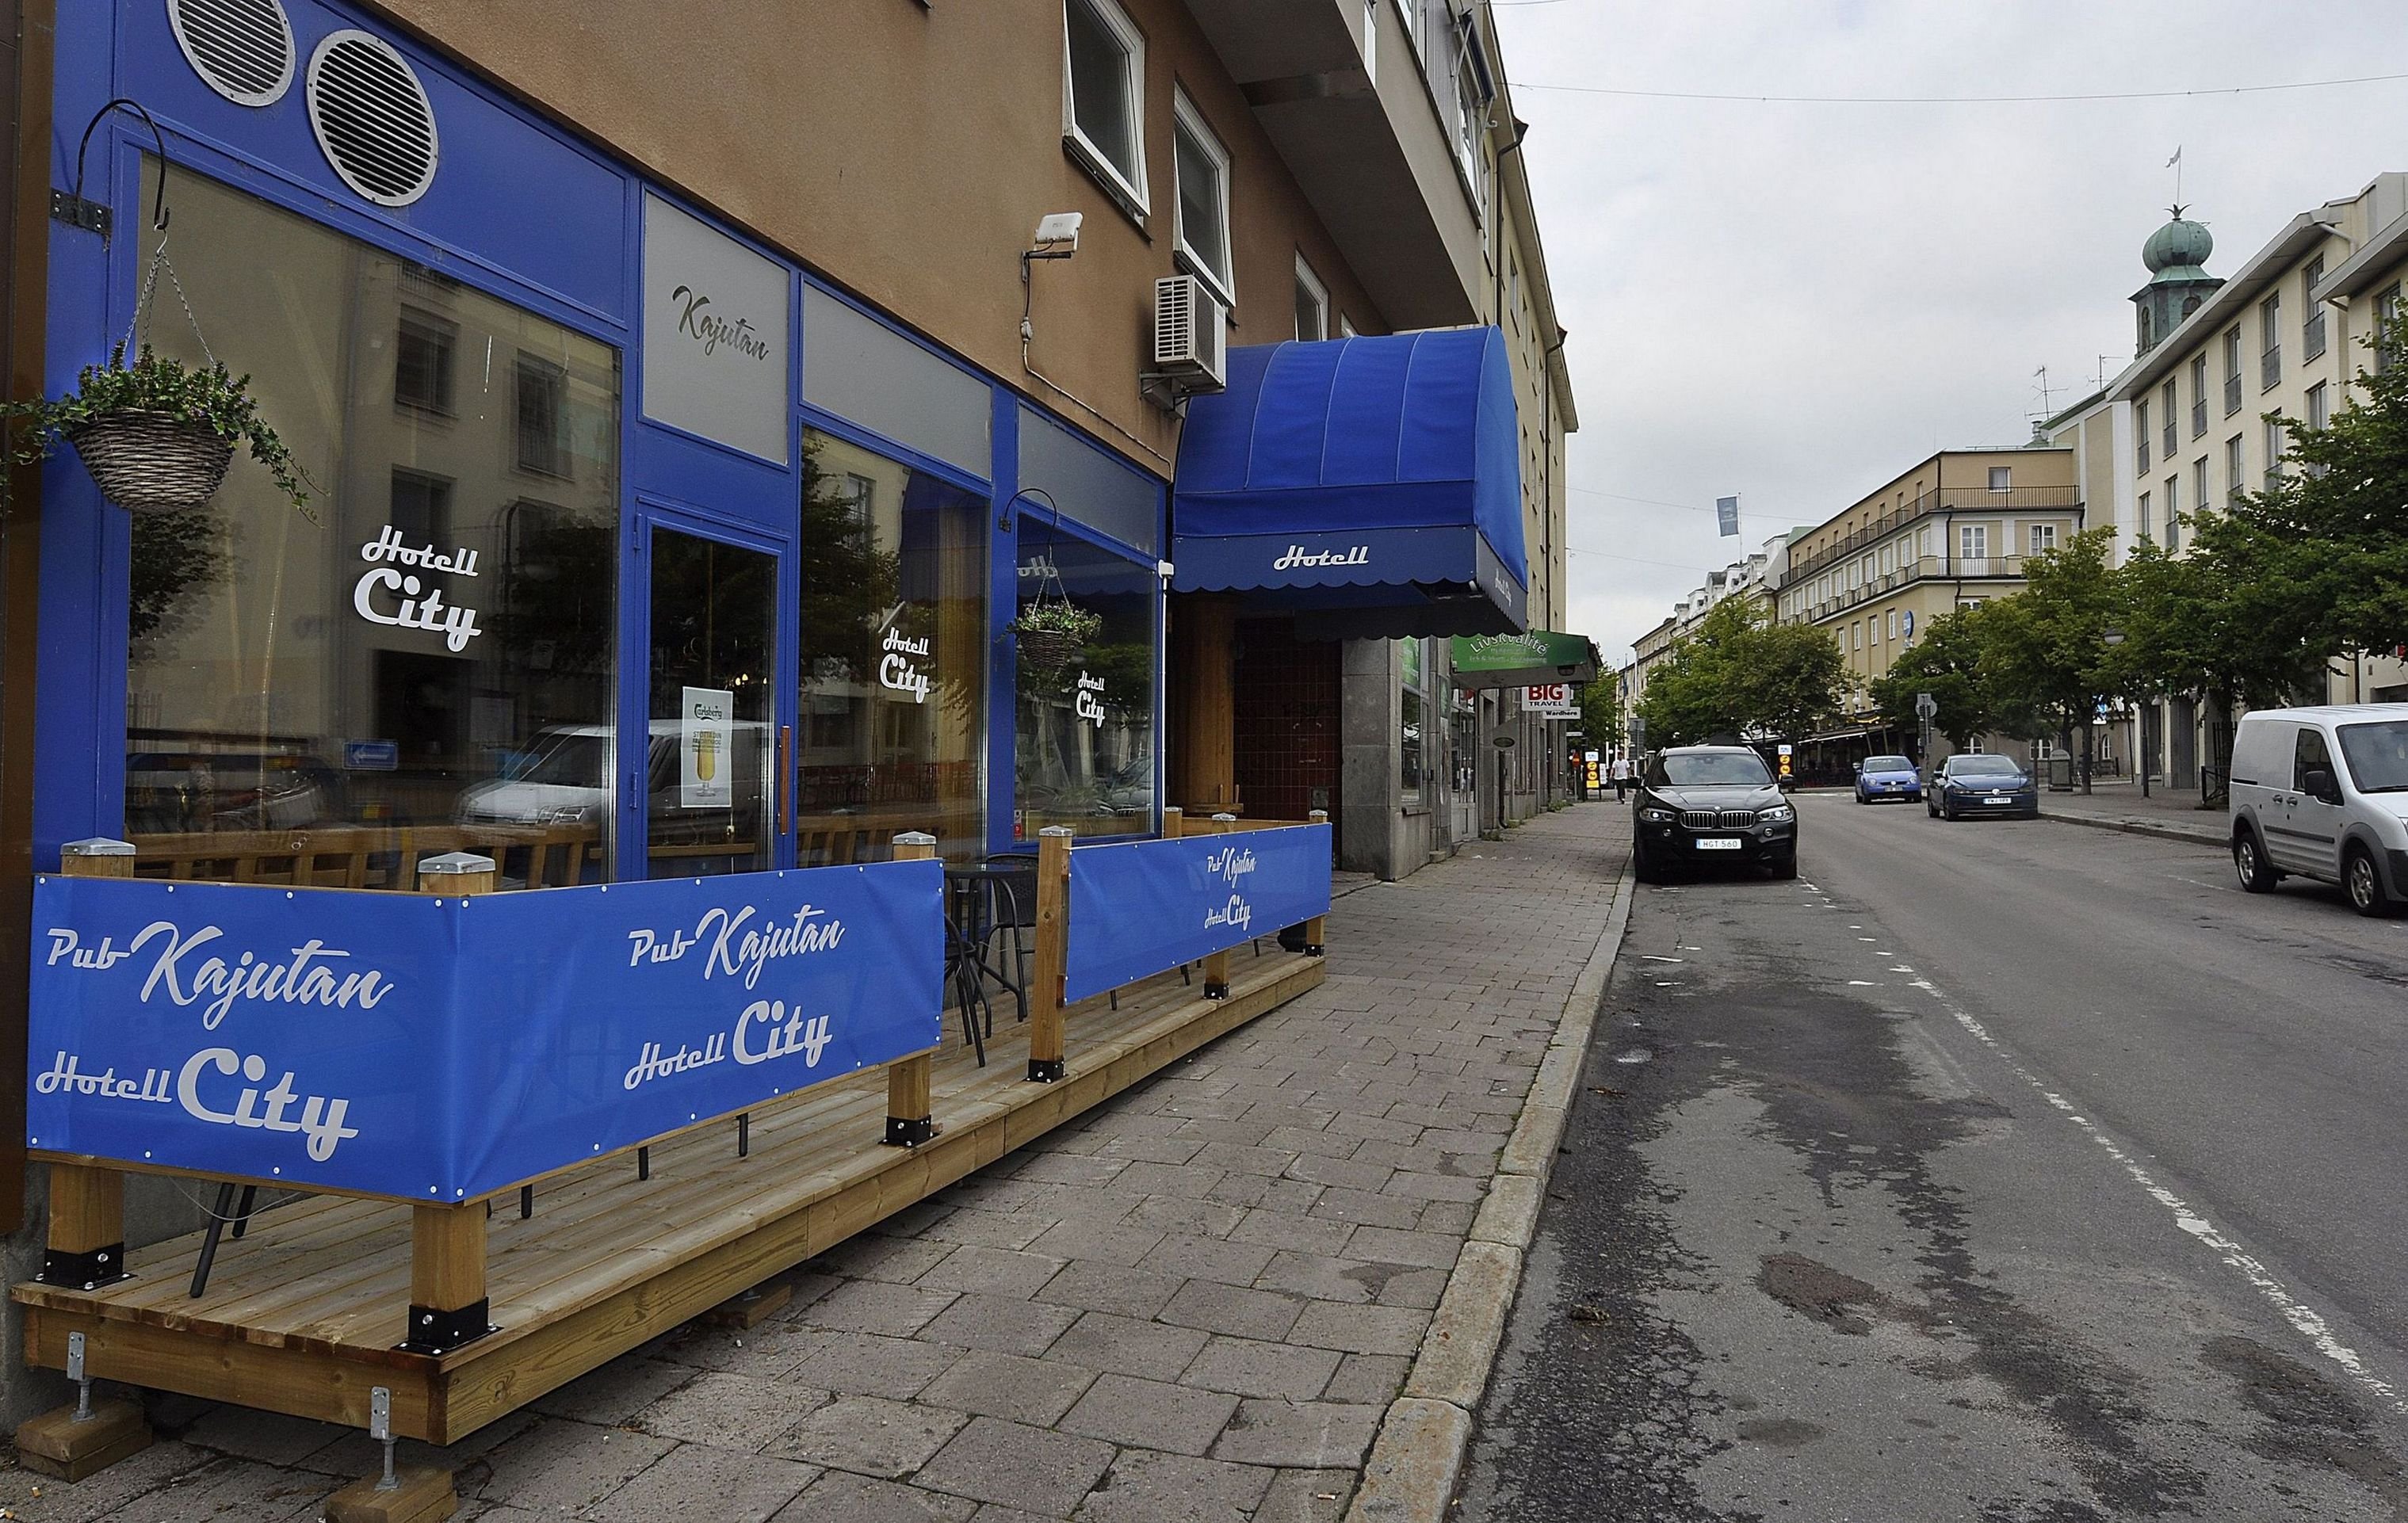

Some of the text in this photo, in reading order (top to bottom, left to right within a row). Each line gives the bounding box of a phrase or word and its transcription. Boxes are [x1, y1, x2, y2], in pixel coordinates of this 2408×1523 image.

[672, 285, 769, 361] Kajutan
[361, 525, 479, 577] Hotell
[1273, 544, 1369, 571] Hotell
[354, 567, 482, 652] City
[882, 627, 929, 656] Hotell
[880, 654, 930, 704] City
[1077, 670, 1105, 691] Hotell
[1528, 684, 1563, 700] BIG
[694, 704, 723, 720] Carlsberg
[1076, 690, 1105, 727] City
[1207, 847, 1256, 888] Pub Kajutan
[1205, 894, 1251, 931] Hotell City
[629, 905, 845, 989] Pub Kajutan
[47, 922, 394, 1030] Pub Kajutan
[624, 1000, 832, 1090] Hotell City
[36, 1048, 358, 1162] Hotell City
